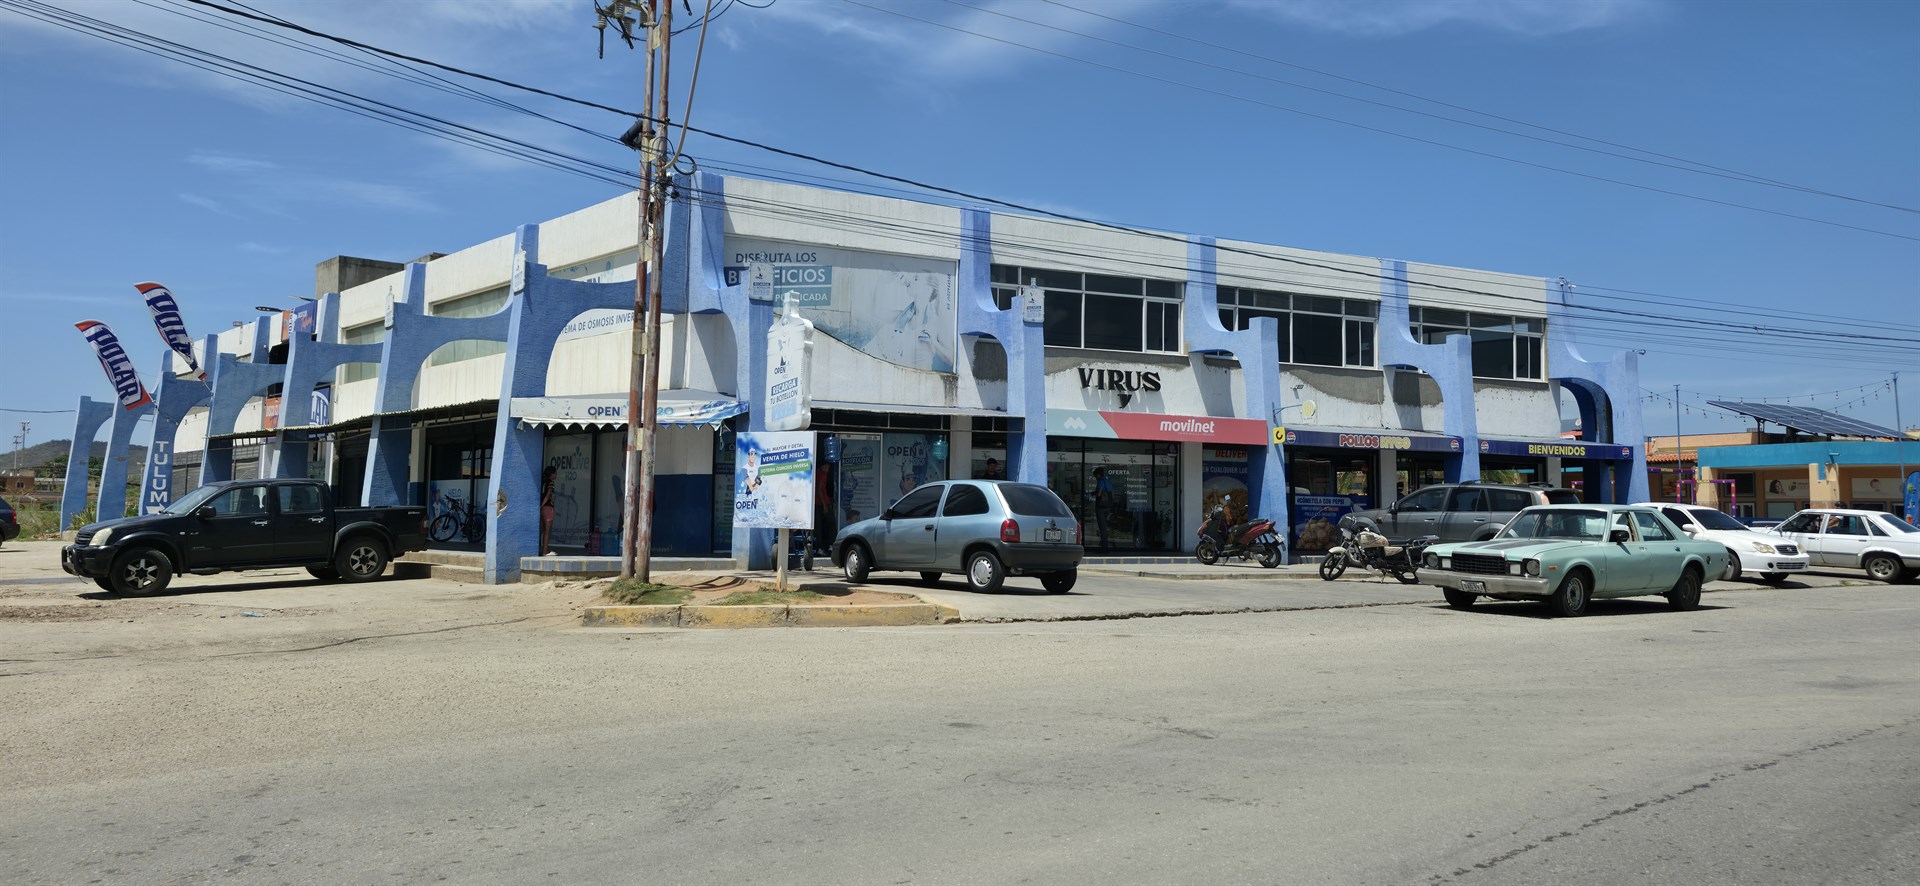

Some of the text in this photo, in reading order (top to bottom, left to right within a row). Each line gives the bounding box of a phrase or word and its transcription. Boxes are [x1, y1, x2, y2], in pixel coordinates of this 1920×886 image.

[735, 252, 817, 263] DISFRUTA LOS
[728, 268, 826, 284] BFICIOS
[775, 293, 828, 301] PUICADA
[578, 321, 586, 331] DE
[615, 311, 634, 325] INVER
[85, 326, 138, 401] POLAR
[772, 378, 797, 394] RECARGA
[1077, 367, 1162, 392] VIRUS
[657, 406, 674, 416] 2O
[1159, 419, 1215, 433] movilnet
[1339, 434, 1412, 449] POLLOS NYCO
[762, 454, 780, 463] VENTA
[789, 451, 805, 459] HIELO
[1215, 449, 1247, 459] DELIVER
[1528, 444, 1586, 456] BIENVENIDOS
[150, 441, 169, 502] TULUM
[1210, 466, 1238, 474] CUALQUIER
